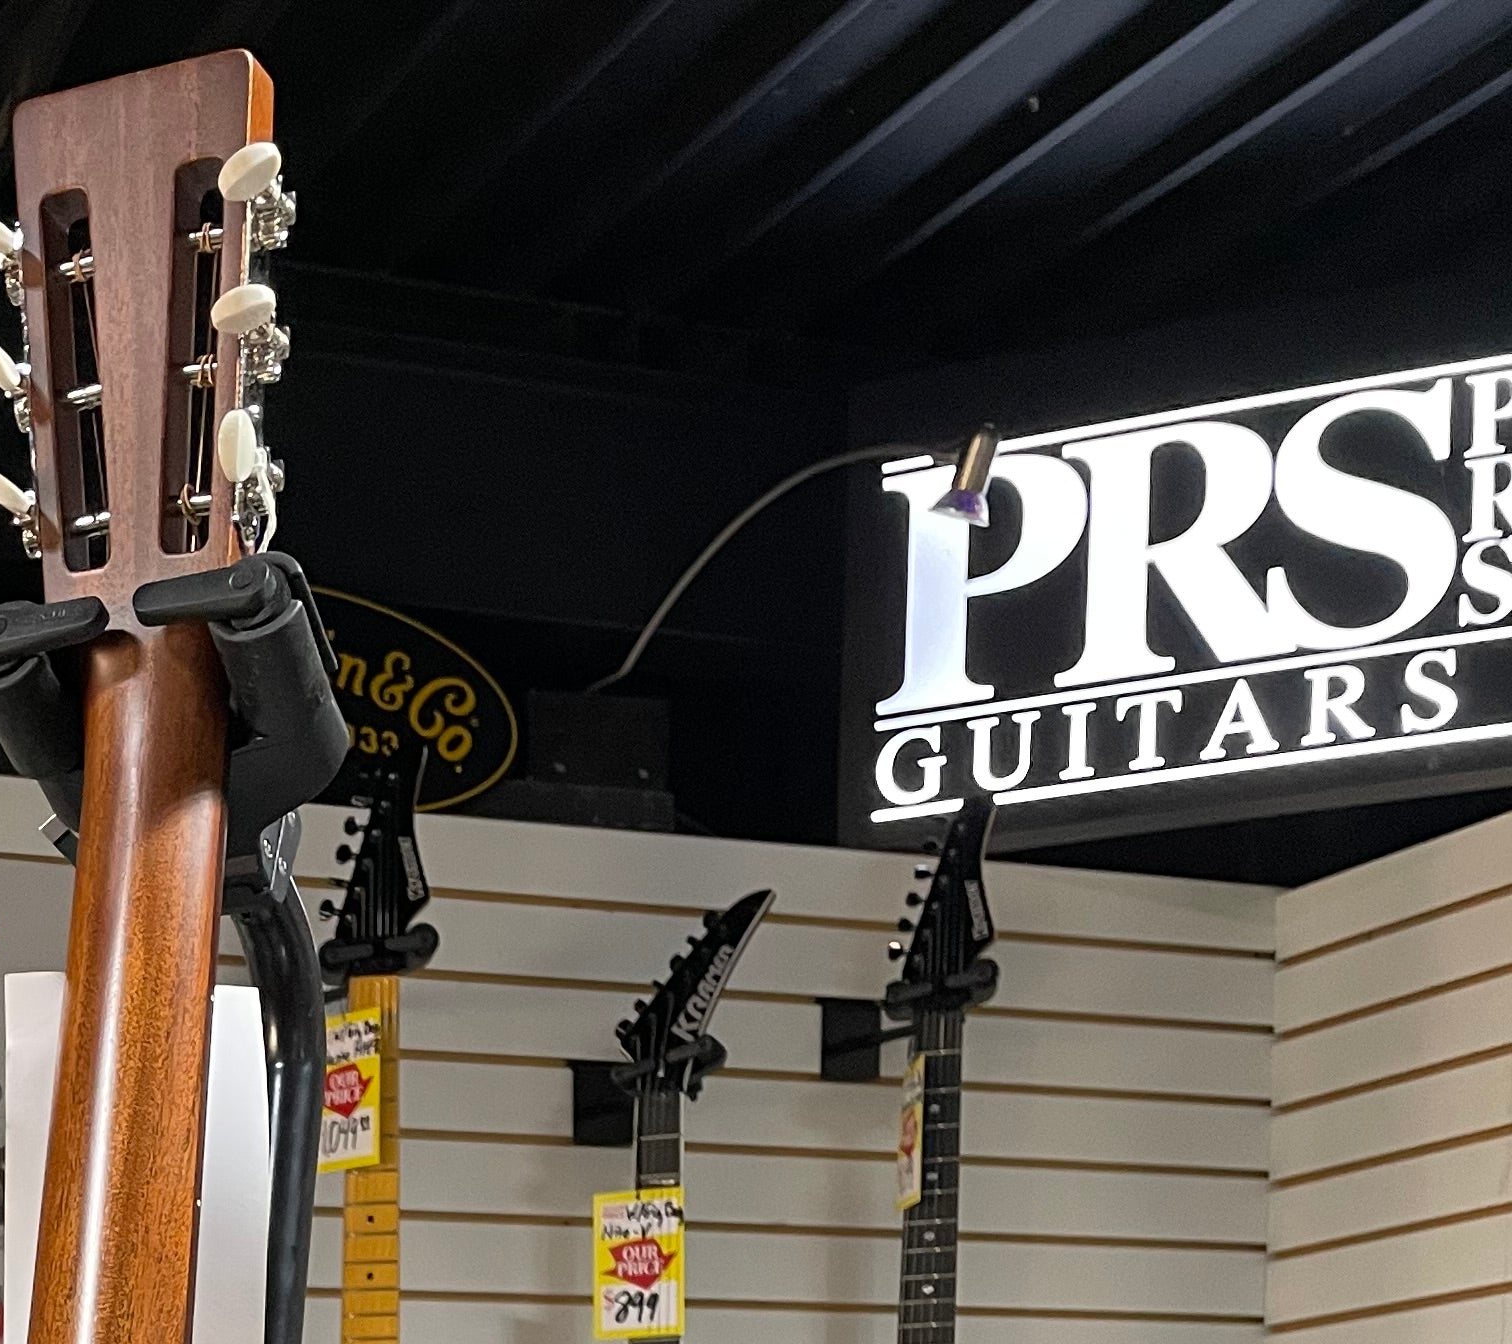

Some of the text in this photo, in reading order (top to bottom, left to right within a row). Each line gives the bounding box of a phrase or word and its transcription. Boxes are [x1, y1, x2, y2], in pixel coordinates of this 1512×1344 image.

[875, 377, 1459, 717] PRS
[870, 648, 1460, 806] GUITARS
[617, 1260, 663, 1278] PRICE
[622, 1244, 659, 1261] OUR
